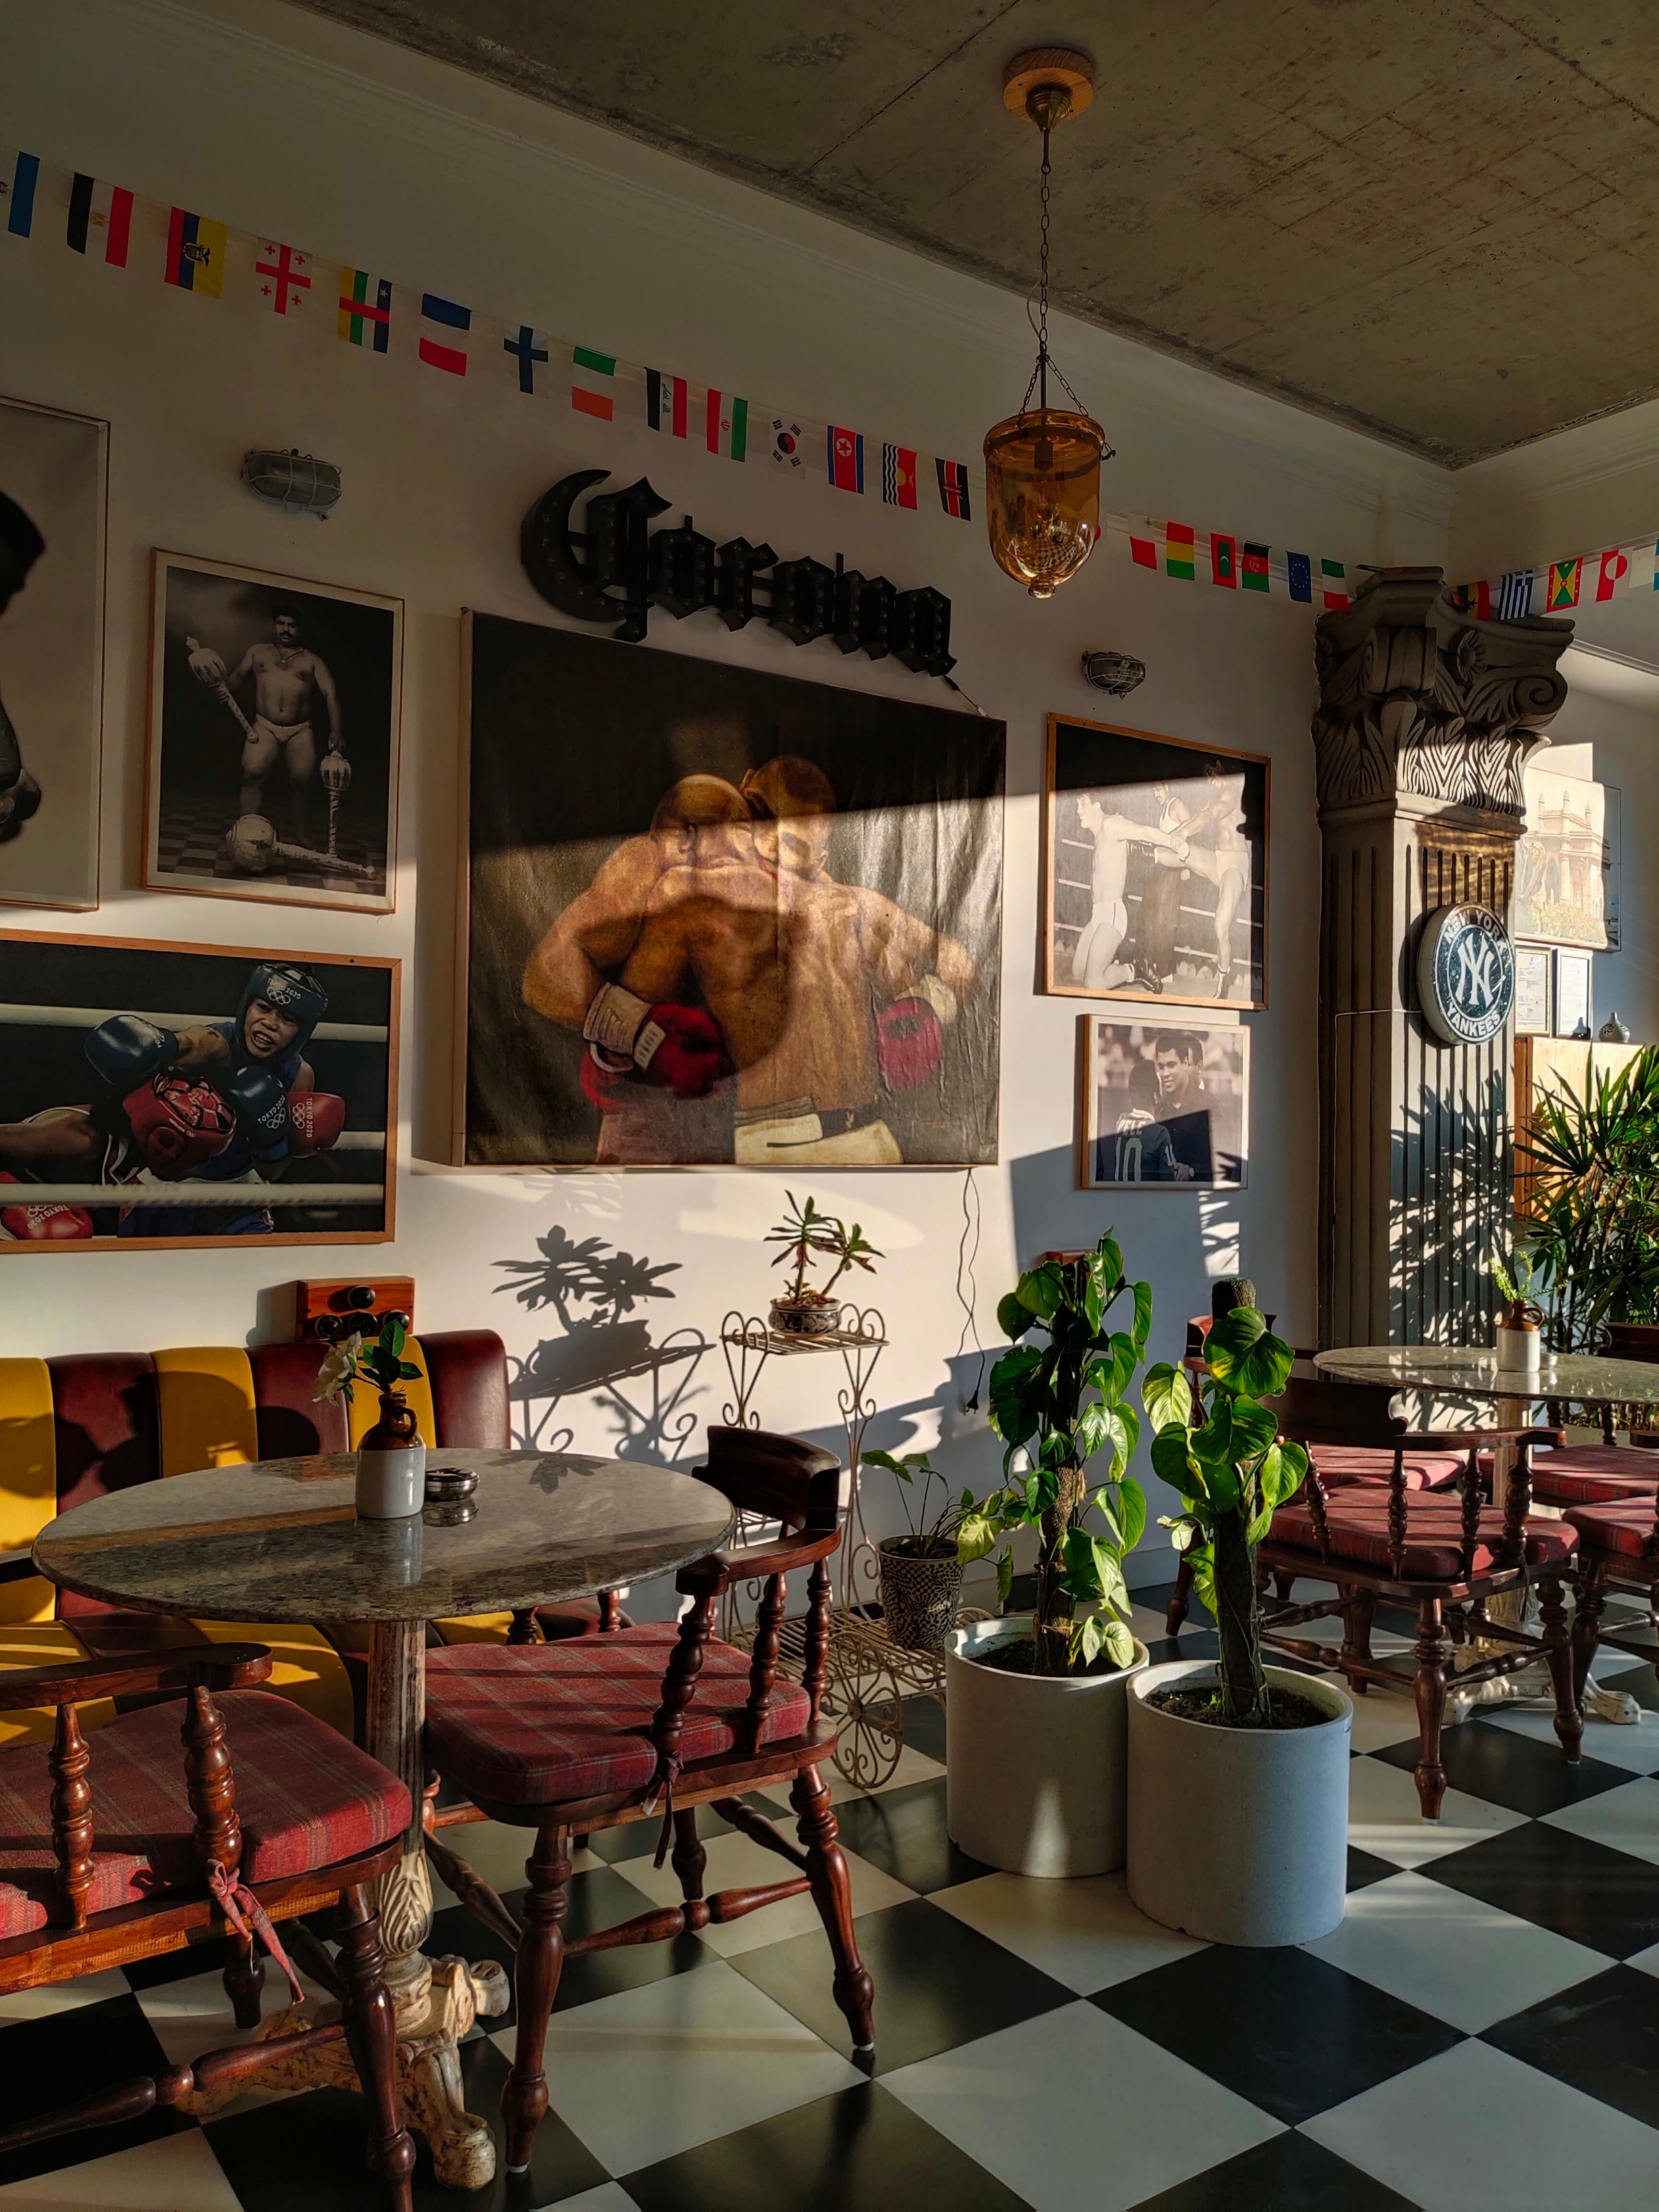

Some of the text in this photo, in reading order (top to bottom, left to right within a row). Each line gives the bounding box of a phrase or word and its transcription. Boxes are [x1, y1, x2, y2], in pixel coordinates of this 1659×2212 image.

[520, 469, 958, 677] Corona
[1444, 910, 1508, 955] NEW YORK
[267, 978, 301, 1000] TOO 2020
[1447, 1001, 1501, 1036] YANKEES
[257, 1107, 277, 1124] TOKYO
[1115, 1136, 1142, 1181] 10
[27, 1204, 69, 1229] TOKYO 2020
